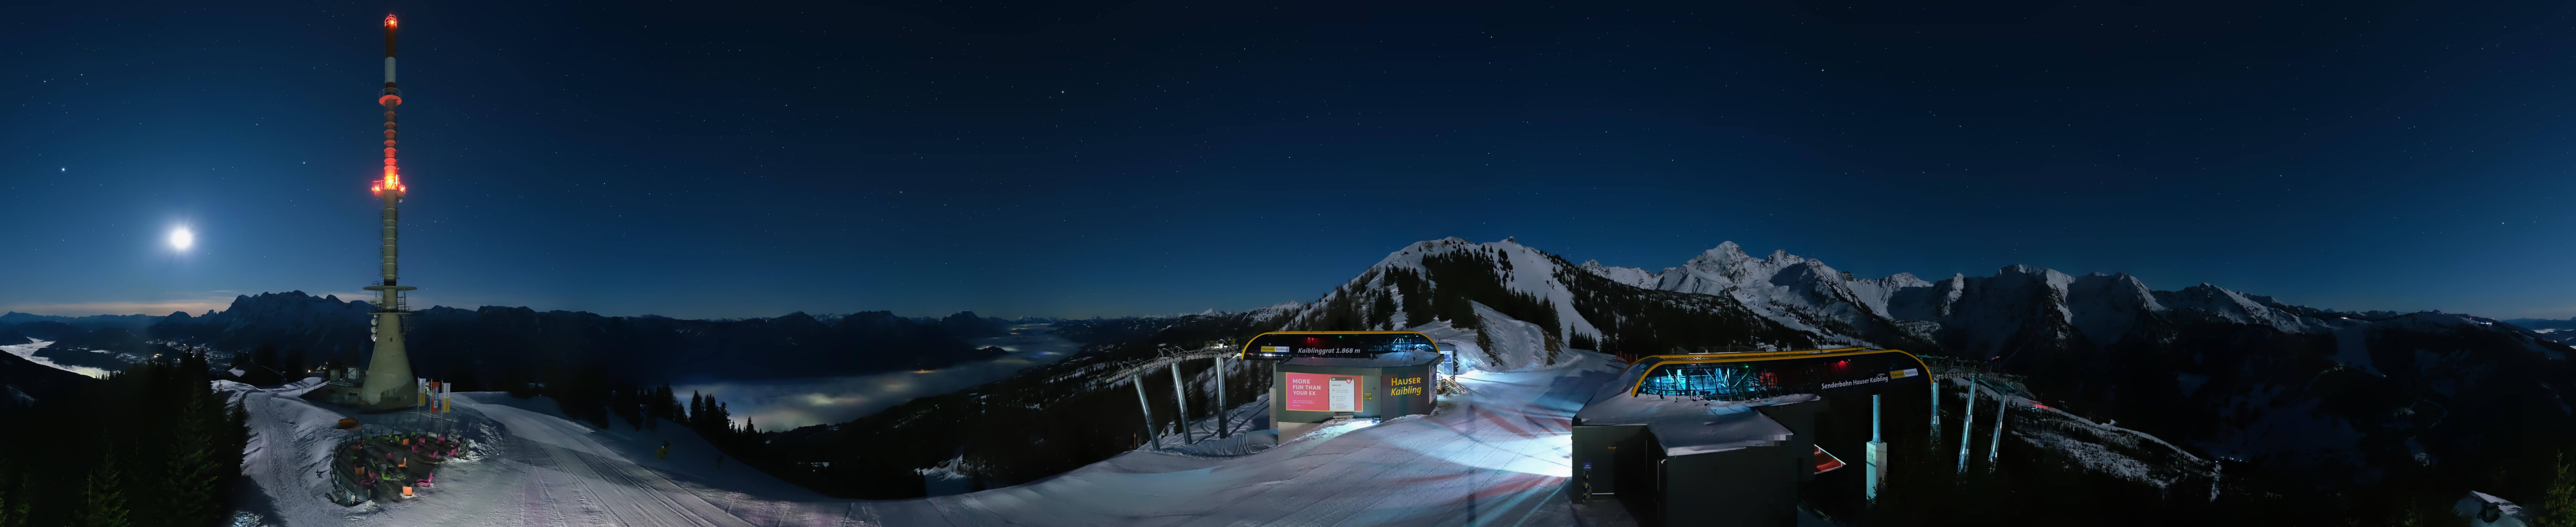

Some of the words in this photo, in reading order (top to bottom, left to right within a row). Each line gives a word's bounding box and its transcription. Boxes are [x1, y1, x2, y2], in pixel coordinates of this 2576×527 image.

[1391, 377, 1421, 386] HAUSER
[1822, 380, 1852, 389] Senderbahn
[1391, 386, 1421, 396] Kaibling
